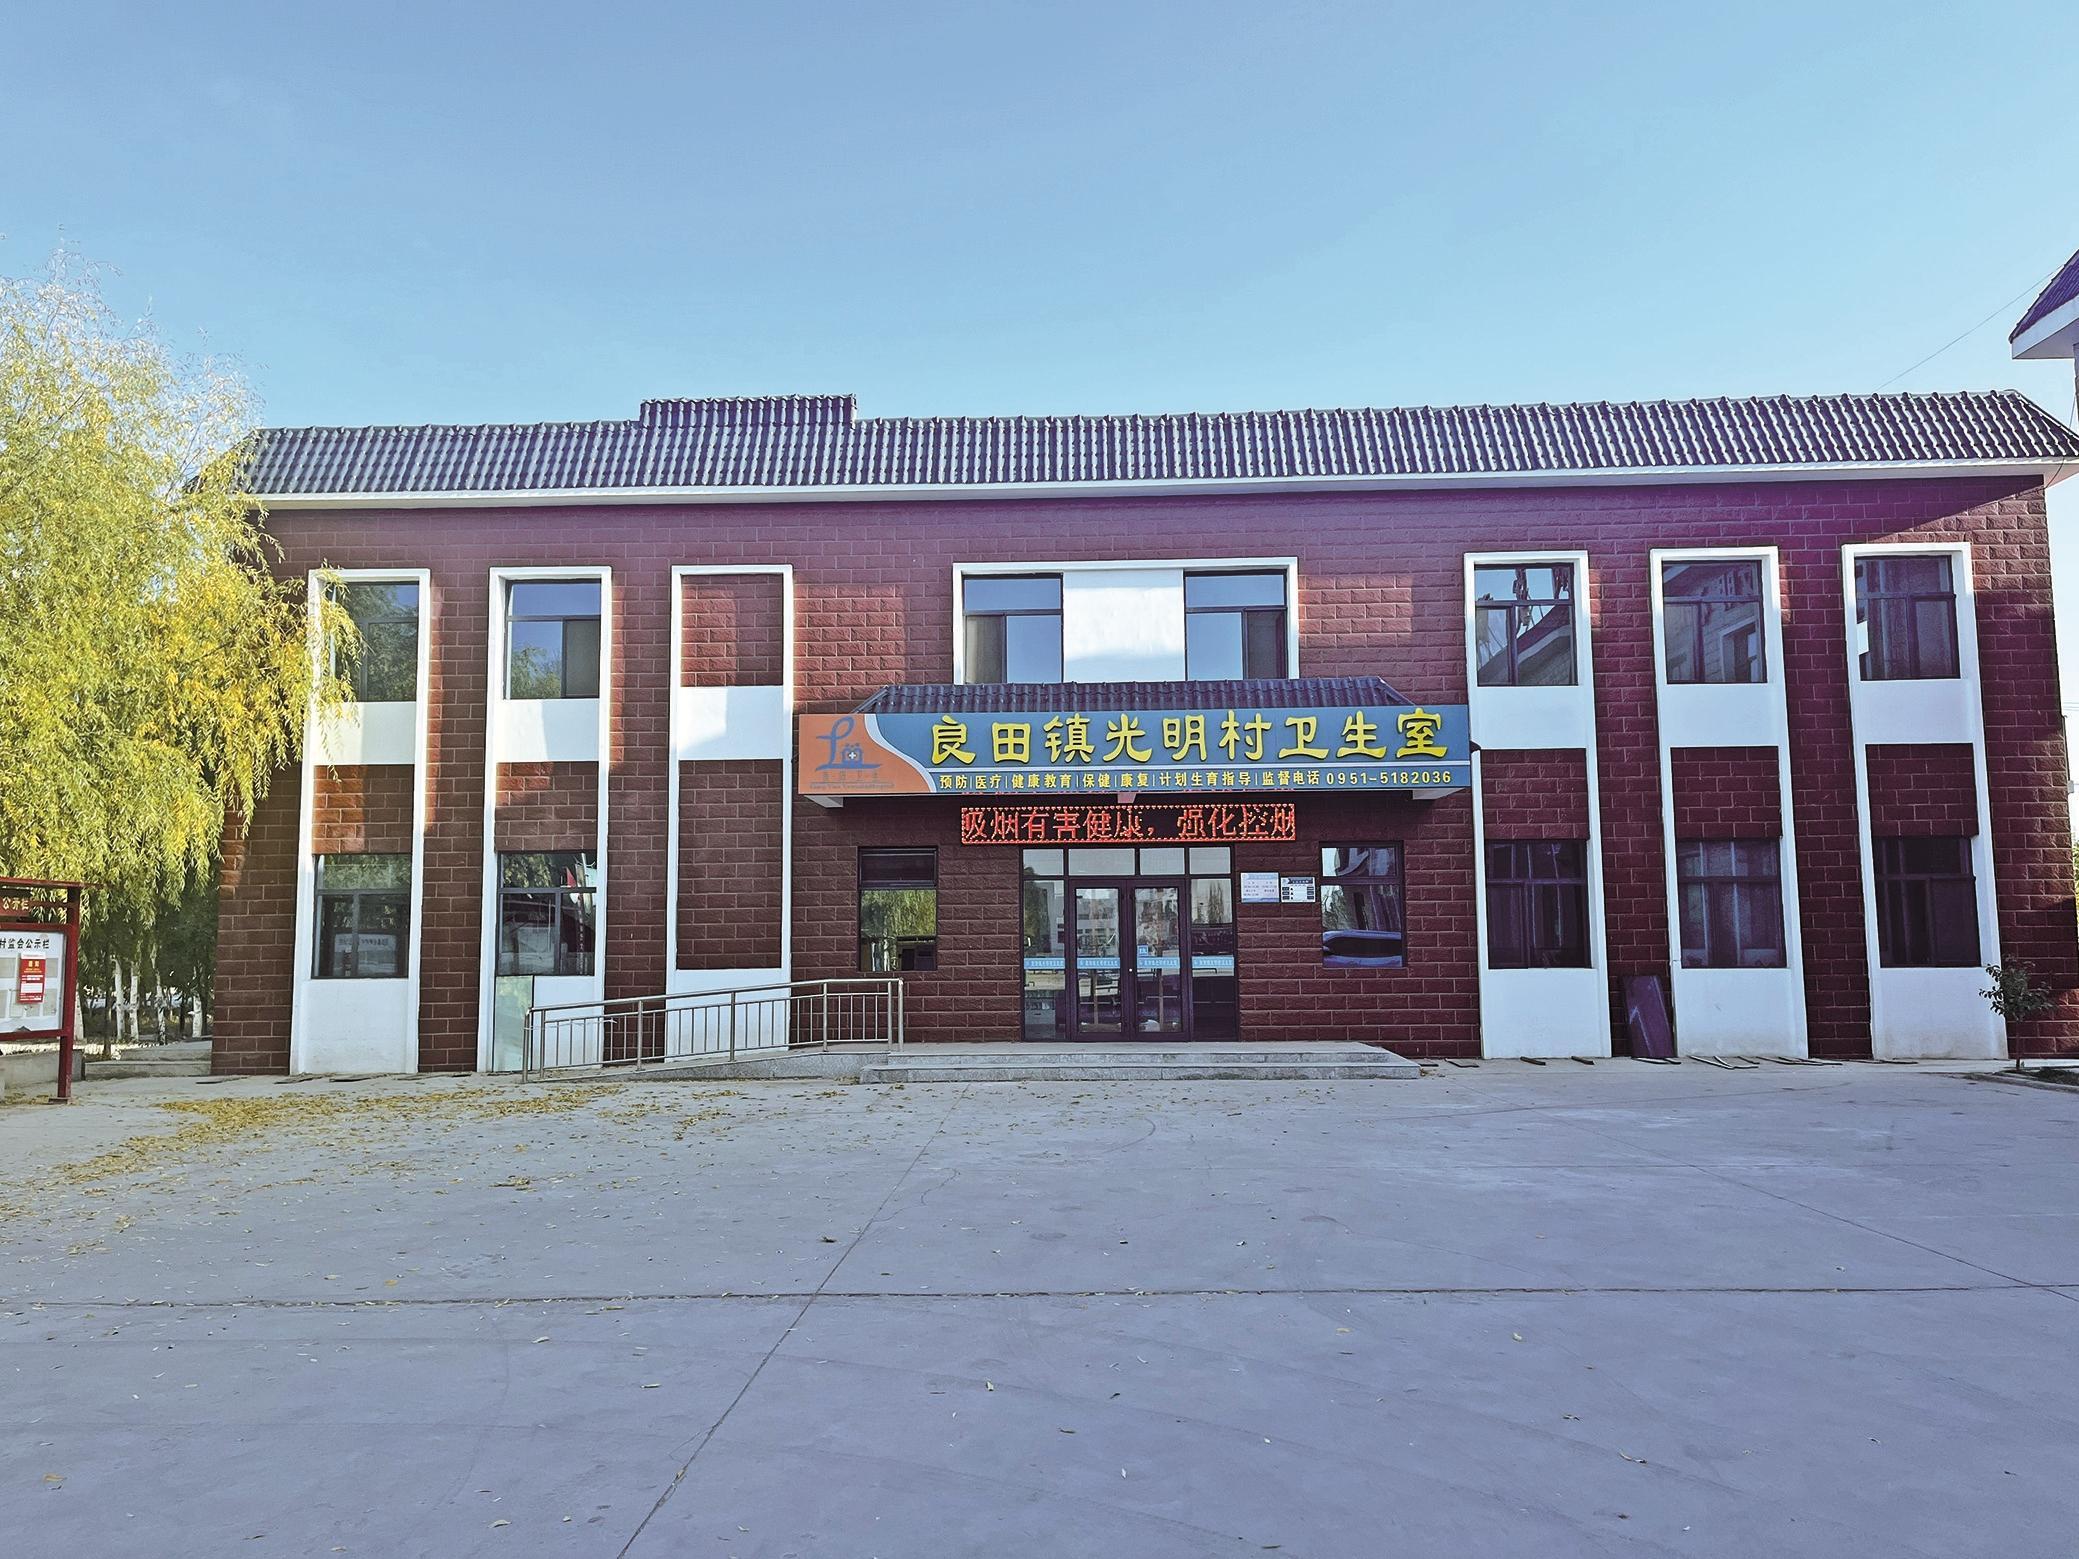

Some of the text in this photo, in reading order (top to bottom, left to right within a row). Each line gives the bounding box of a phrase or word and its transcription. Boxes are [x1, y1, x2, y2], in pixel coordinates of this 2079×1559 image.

[931, 707, 1449, 765] 良田镇光明村卫生室
[1012, 773, 1072, 789] 健康教育
[1159, 771, 1251, 787] 计划生育指导
[1261, 770, 1321, 786] 监督电话
[1326, 770, 1451, 785] 0951-5182036
